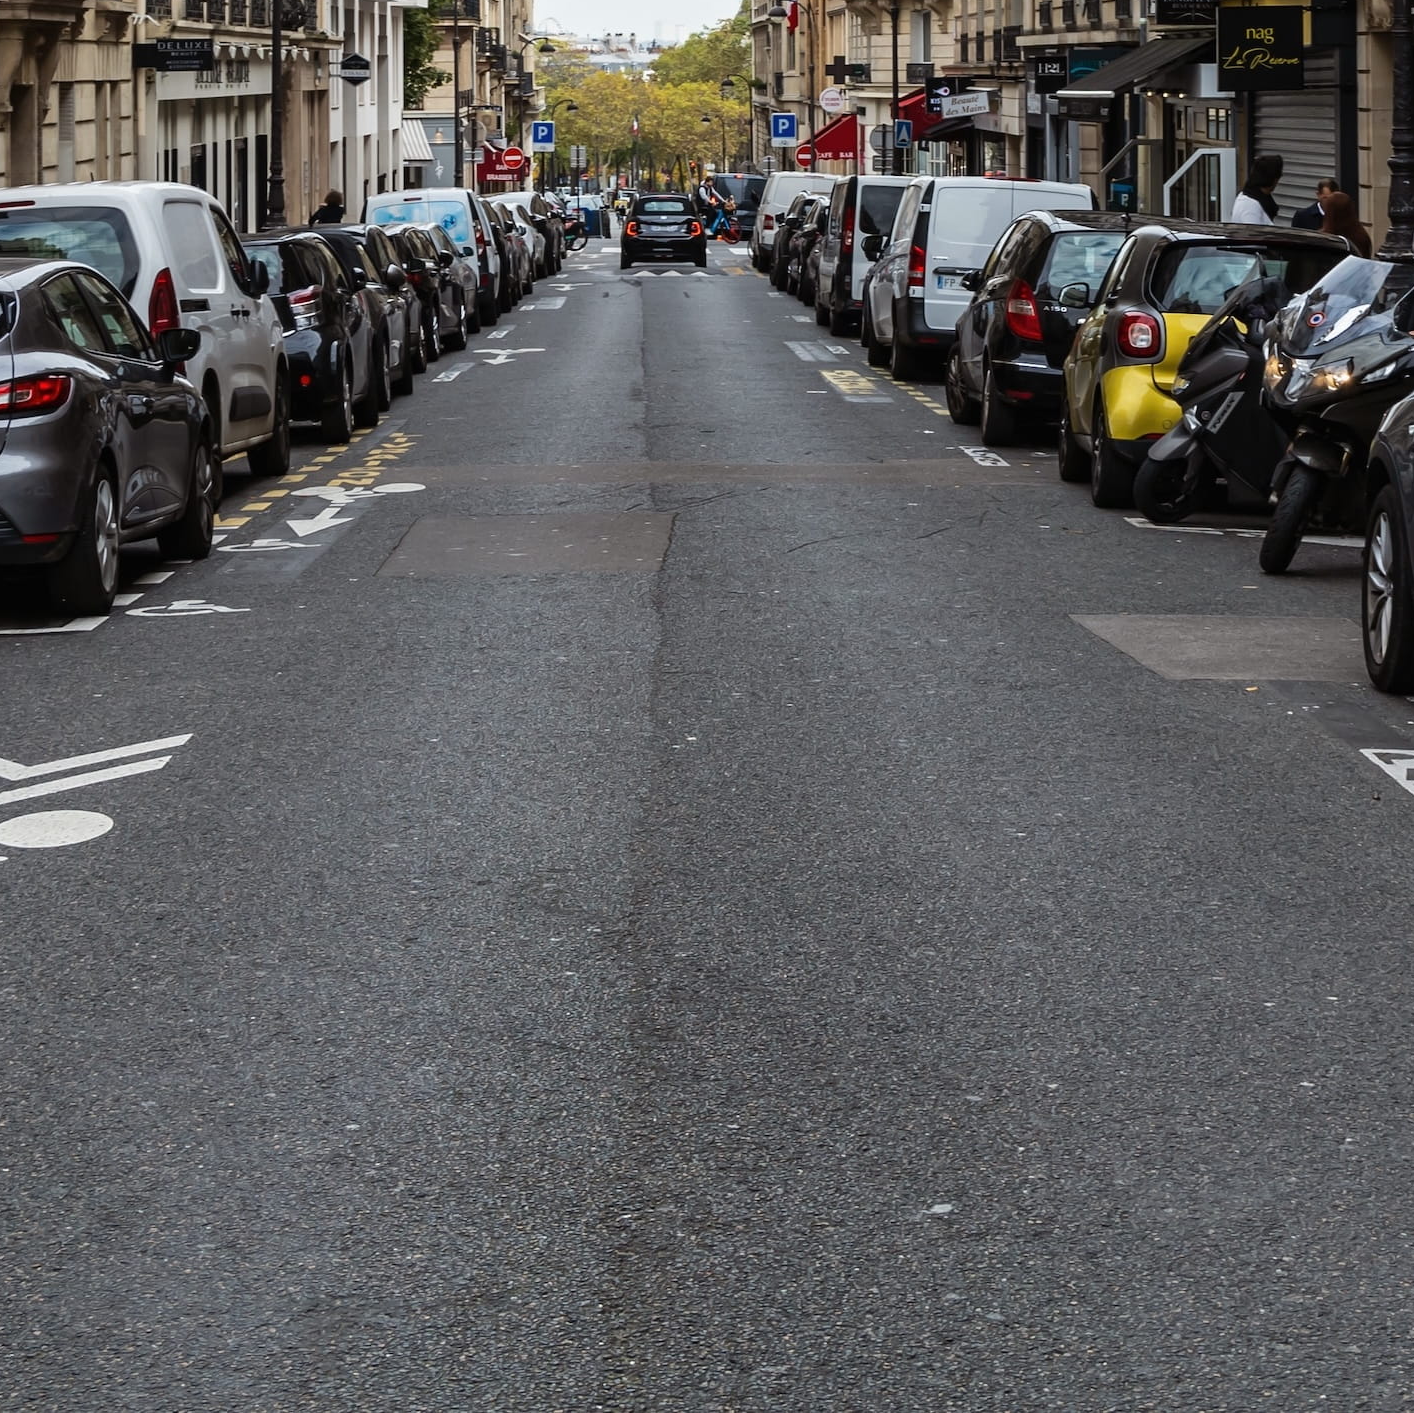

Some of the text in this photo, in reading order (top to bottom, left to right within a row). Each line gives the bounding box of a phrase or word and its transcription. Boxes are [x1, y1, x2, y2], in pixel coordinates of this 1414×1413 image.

[1246, 27, 1275, 44] nag
[157, 41, 212, 50] DELUXE
[1222, 47, 1245, 69] La
[951, 95, 979, 106] Beauté
[946, 106, 960, 116] des
[962, 103, 987, 114] Mains
